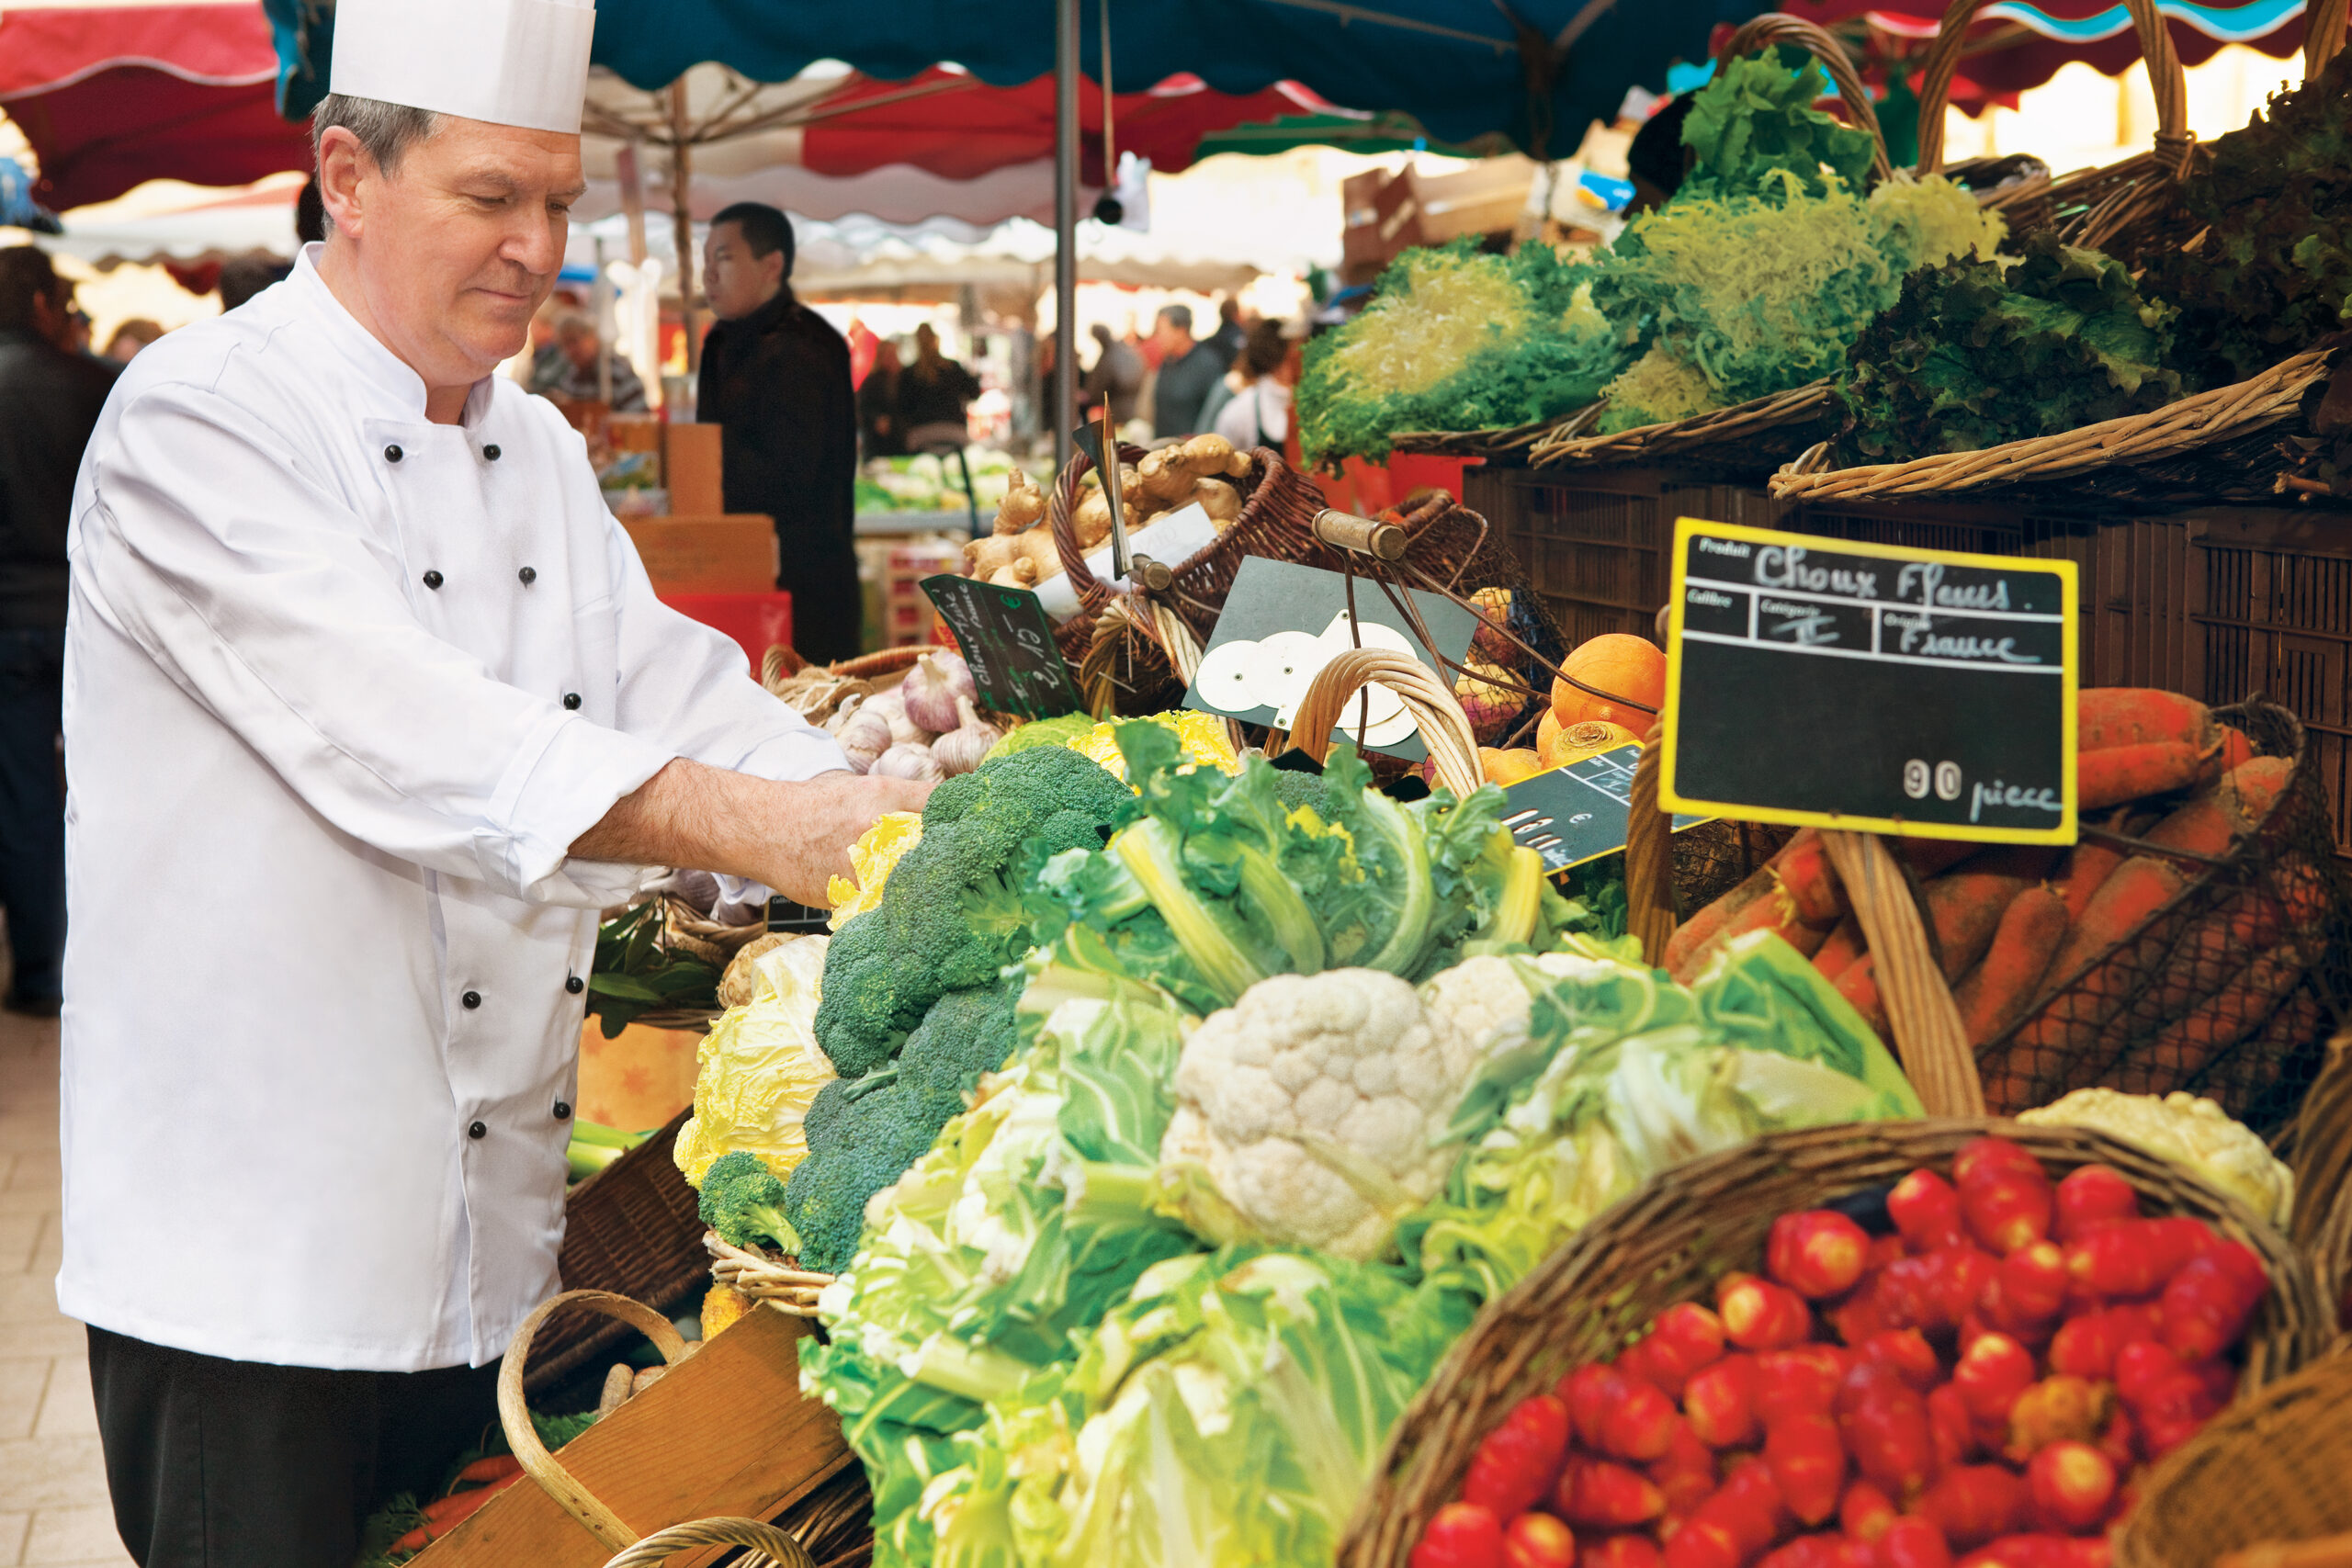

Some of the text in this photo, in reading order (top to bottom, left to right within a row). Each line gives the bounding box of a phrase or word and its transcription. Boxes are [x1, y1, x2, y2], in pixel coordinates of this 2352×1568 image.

[1699, 536, 1751, 558] Produit
[1754, 545, 1877, 598] Choux
[1687, 588, 1733, 608] Calibre
[1899, 628, 2041, 664] France
[1903, 758, 1962, 801] 90
